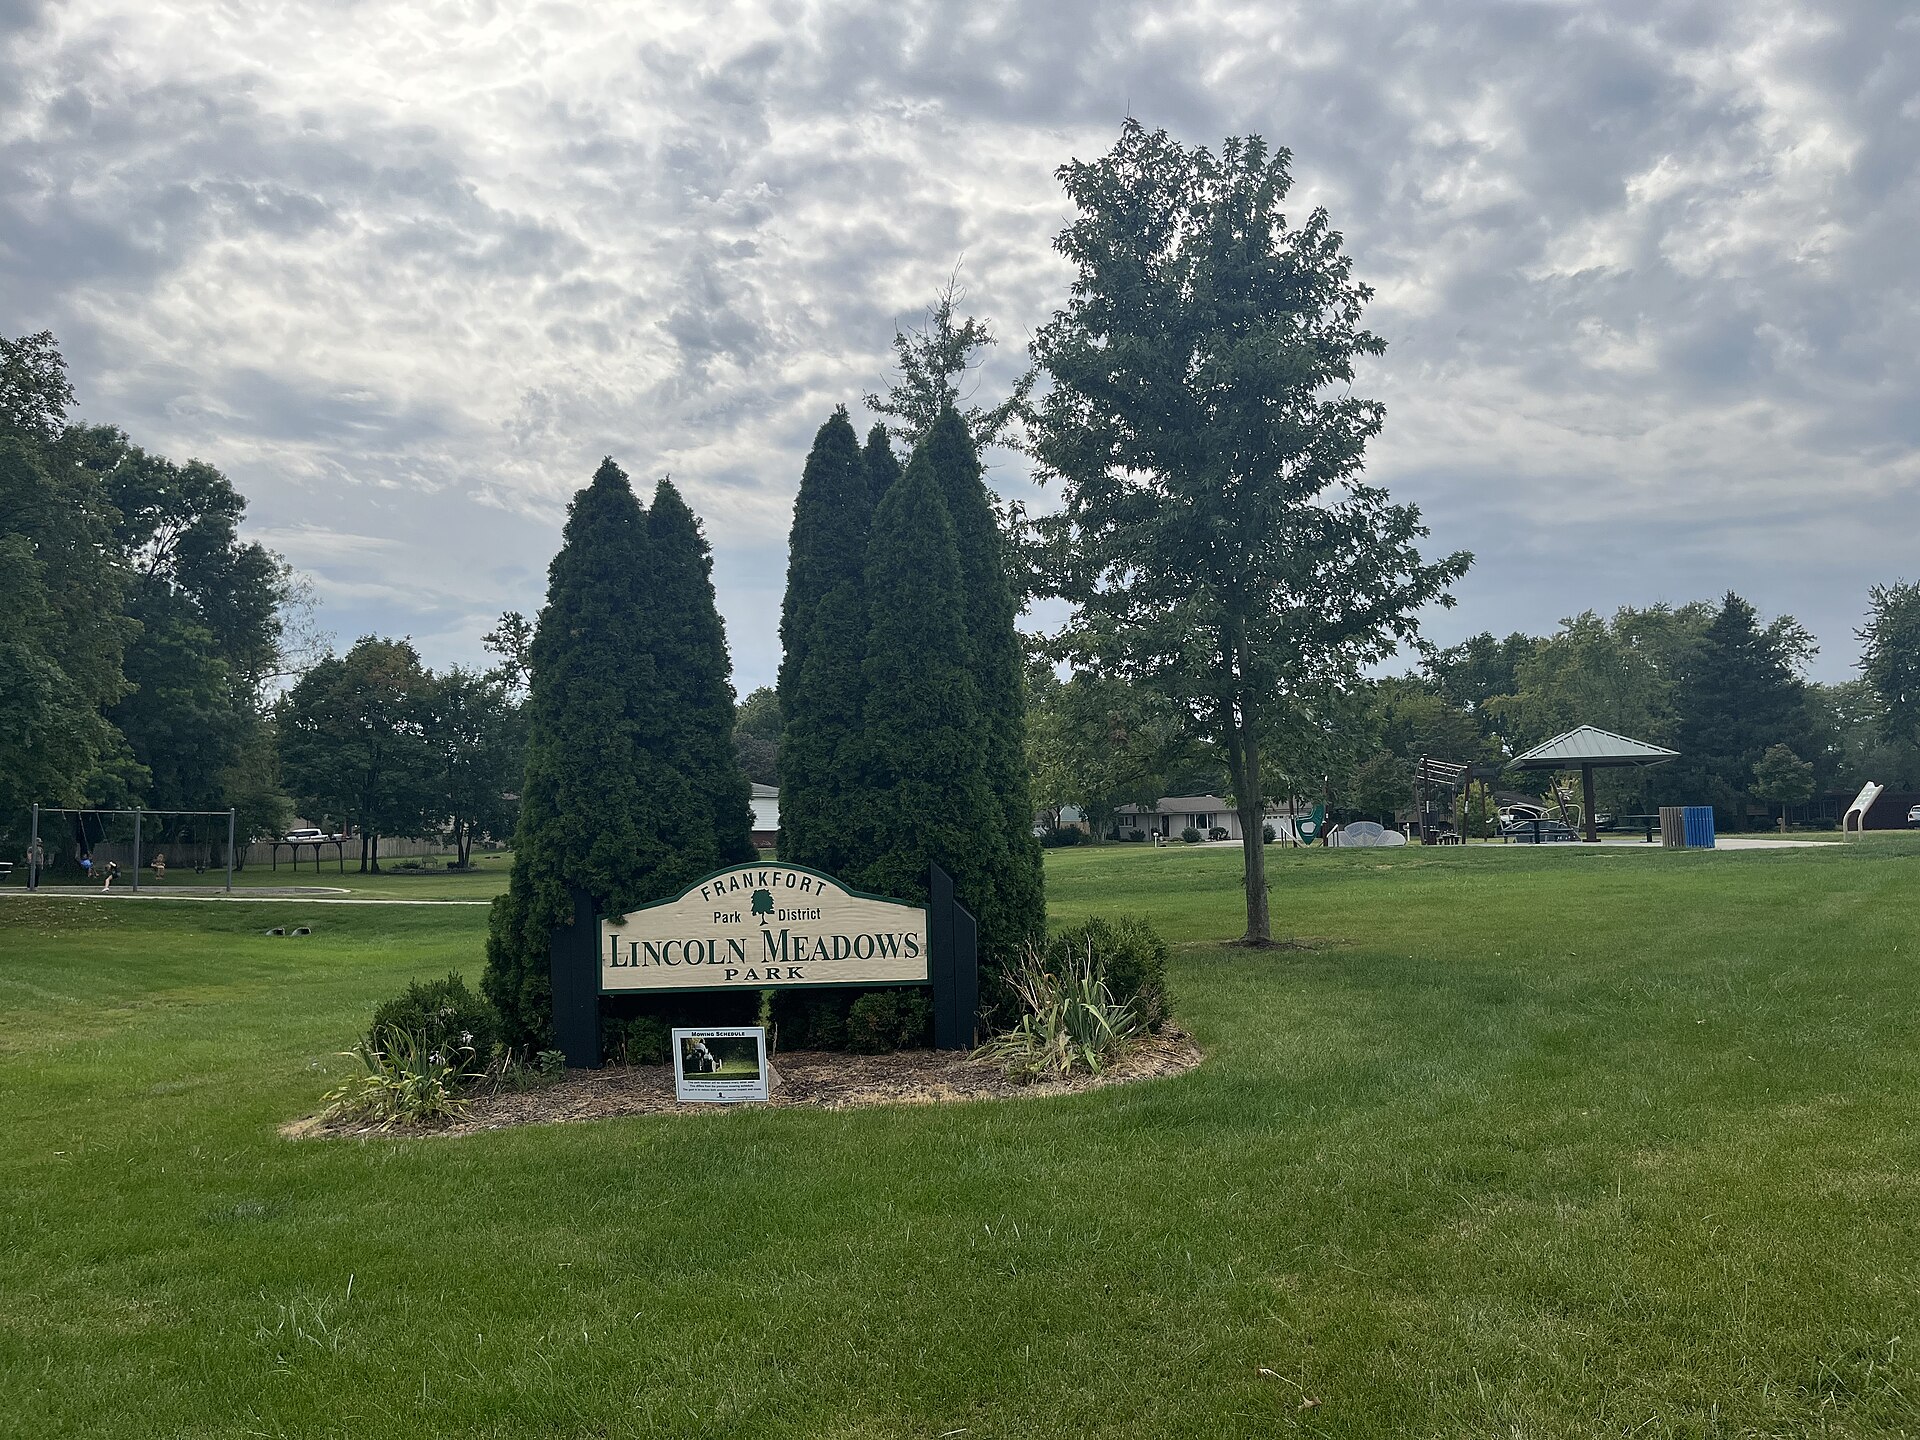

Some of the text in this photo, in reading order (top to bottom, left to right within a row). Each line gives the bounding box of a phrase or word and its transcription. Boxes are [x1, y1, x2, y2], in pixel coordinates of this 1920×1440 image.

[700, 871, 827, 901] FRANKFORT
[713, 908, 821, 924] Park District
[609, 929, 920, 967] LINCOLN MEADOWS
[724, 966, 804, 981] PARK
